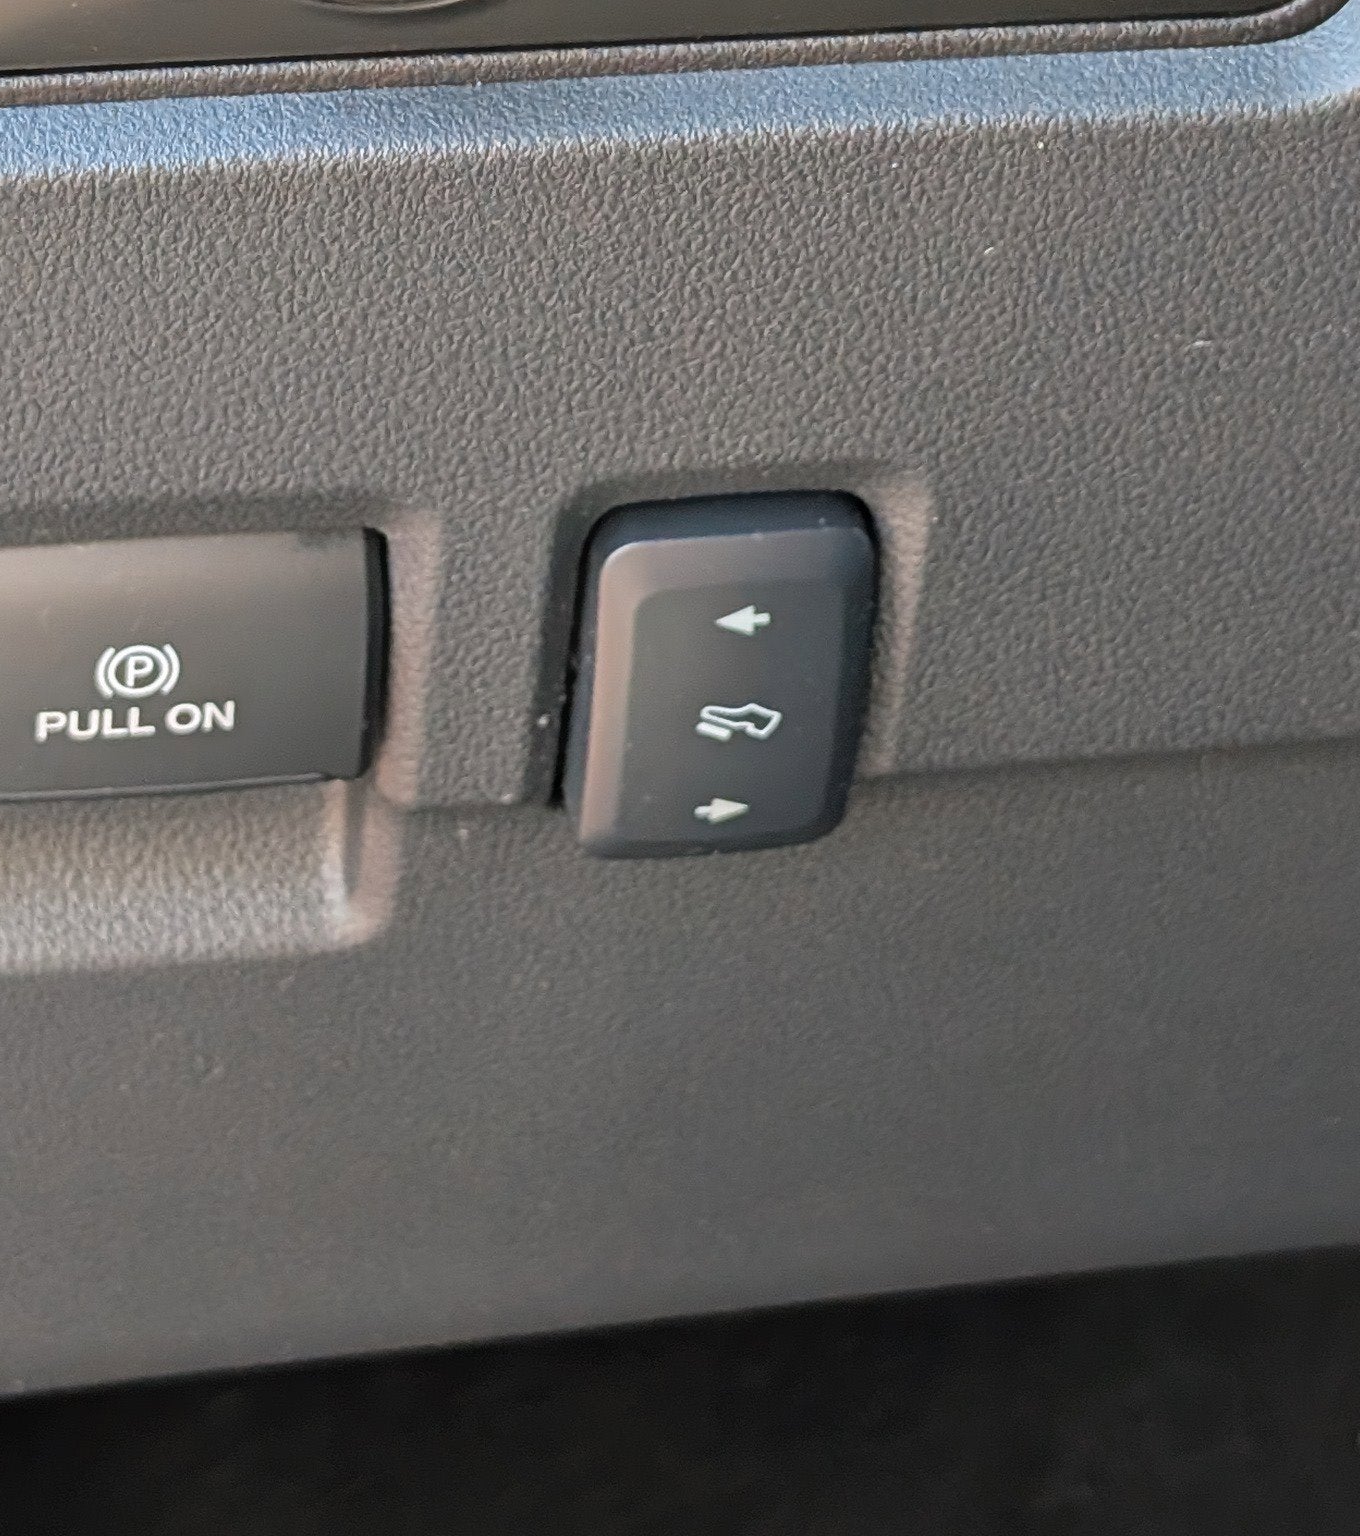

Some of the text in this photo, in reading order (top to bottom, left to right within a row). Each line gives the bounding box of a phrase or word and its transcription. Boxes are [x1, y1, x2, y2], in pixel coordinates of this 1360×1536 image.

[125, 655, 153, 687] P
[36, 699, 235, 742] PULL ON
